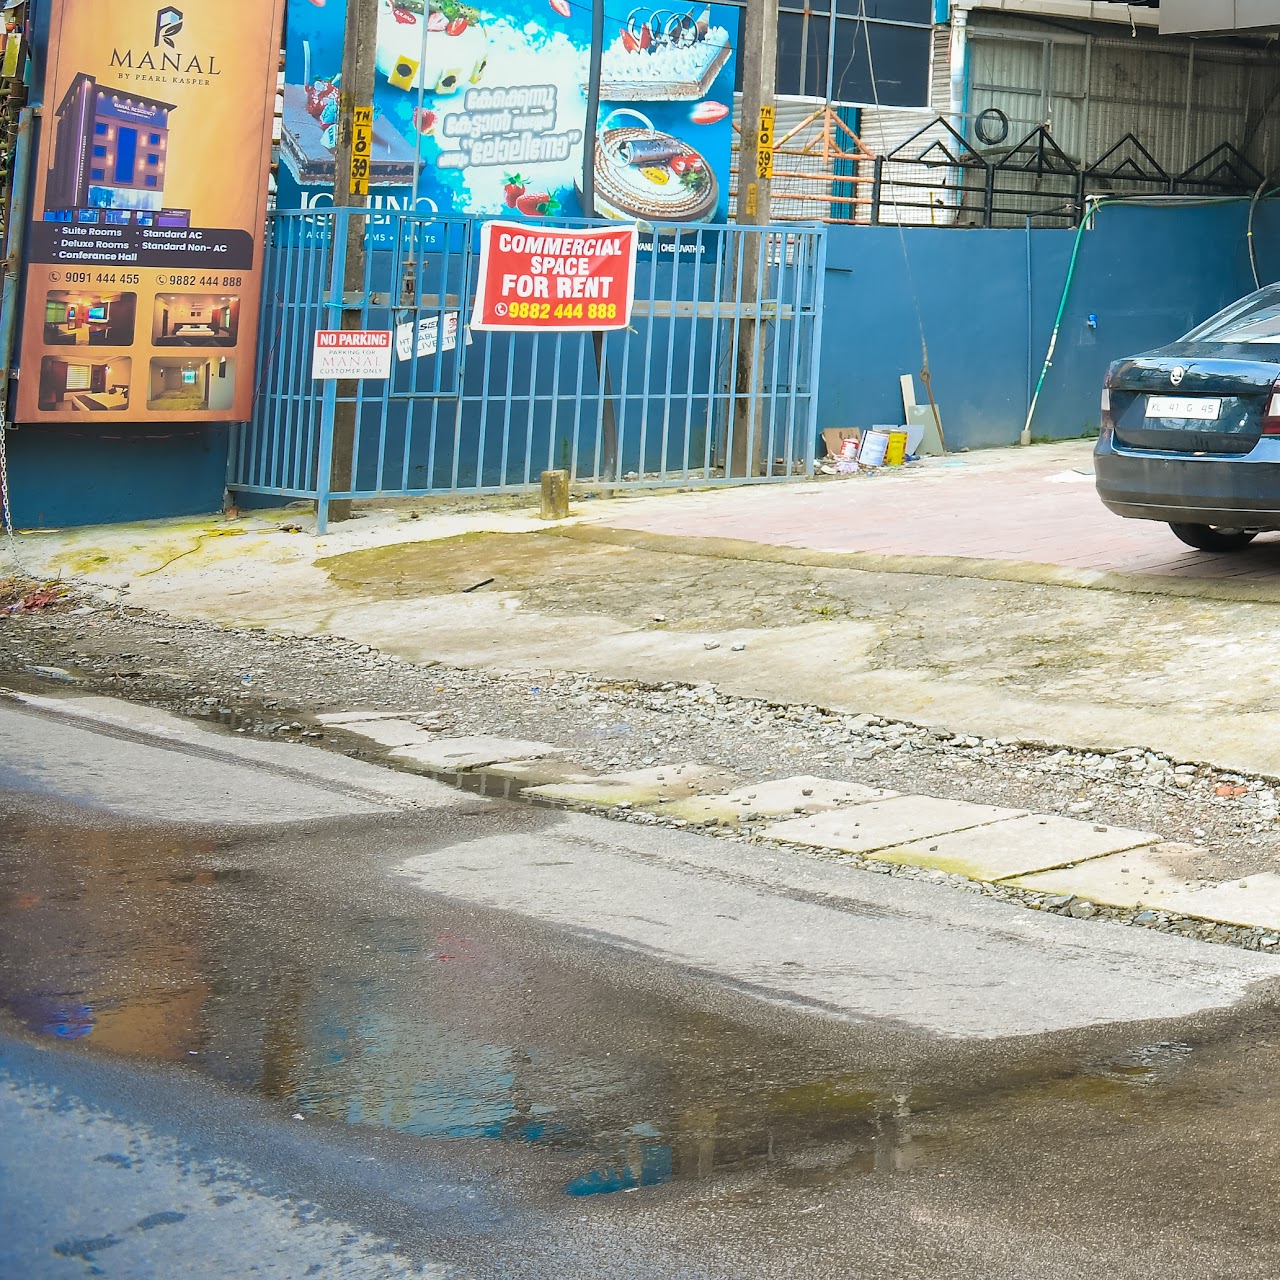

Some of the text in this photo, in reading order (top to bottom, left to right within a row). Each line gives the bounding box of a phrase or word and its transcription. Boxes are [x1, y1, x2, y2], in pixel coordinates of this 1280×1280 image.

[108, 48, 222, 75] MANAL
[118, 72, 210, 86] BY PEARL KASPER
[758, 151, 771, 167] 39
[351, 158, 368, 178] 39
[62, 226, 122, 237] Suite Rooms
[143, 229, 203, 240] Standard AC
[60, 239, 129, 250] Deluxe Rooms
[142, 241, 227, 253] Standard Non- AC
[499, 233, 622, 257] COMMERCIAL
[58, 251, 138, 261] Conferance Hall
[530, 257, 590, 276] SPACE
[65, 272, 140, 285] 9091 444 455
[169, 275, 242, 287] 9882 444 888
[501, 274, 614, 299] FOR RENT
[508, 302, 616, 319] 9882 444 888
[320, 333, 387, 346] NO PARKING
[322, 356, 382, 367] MANAL
